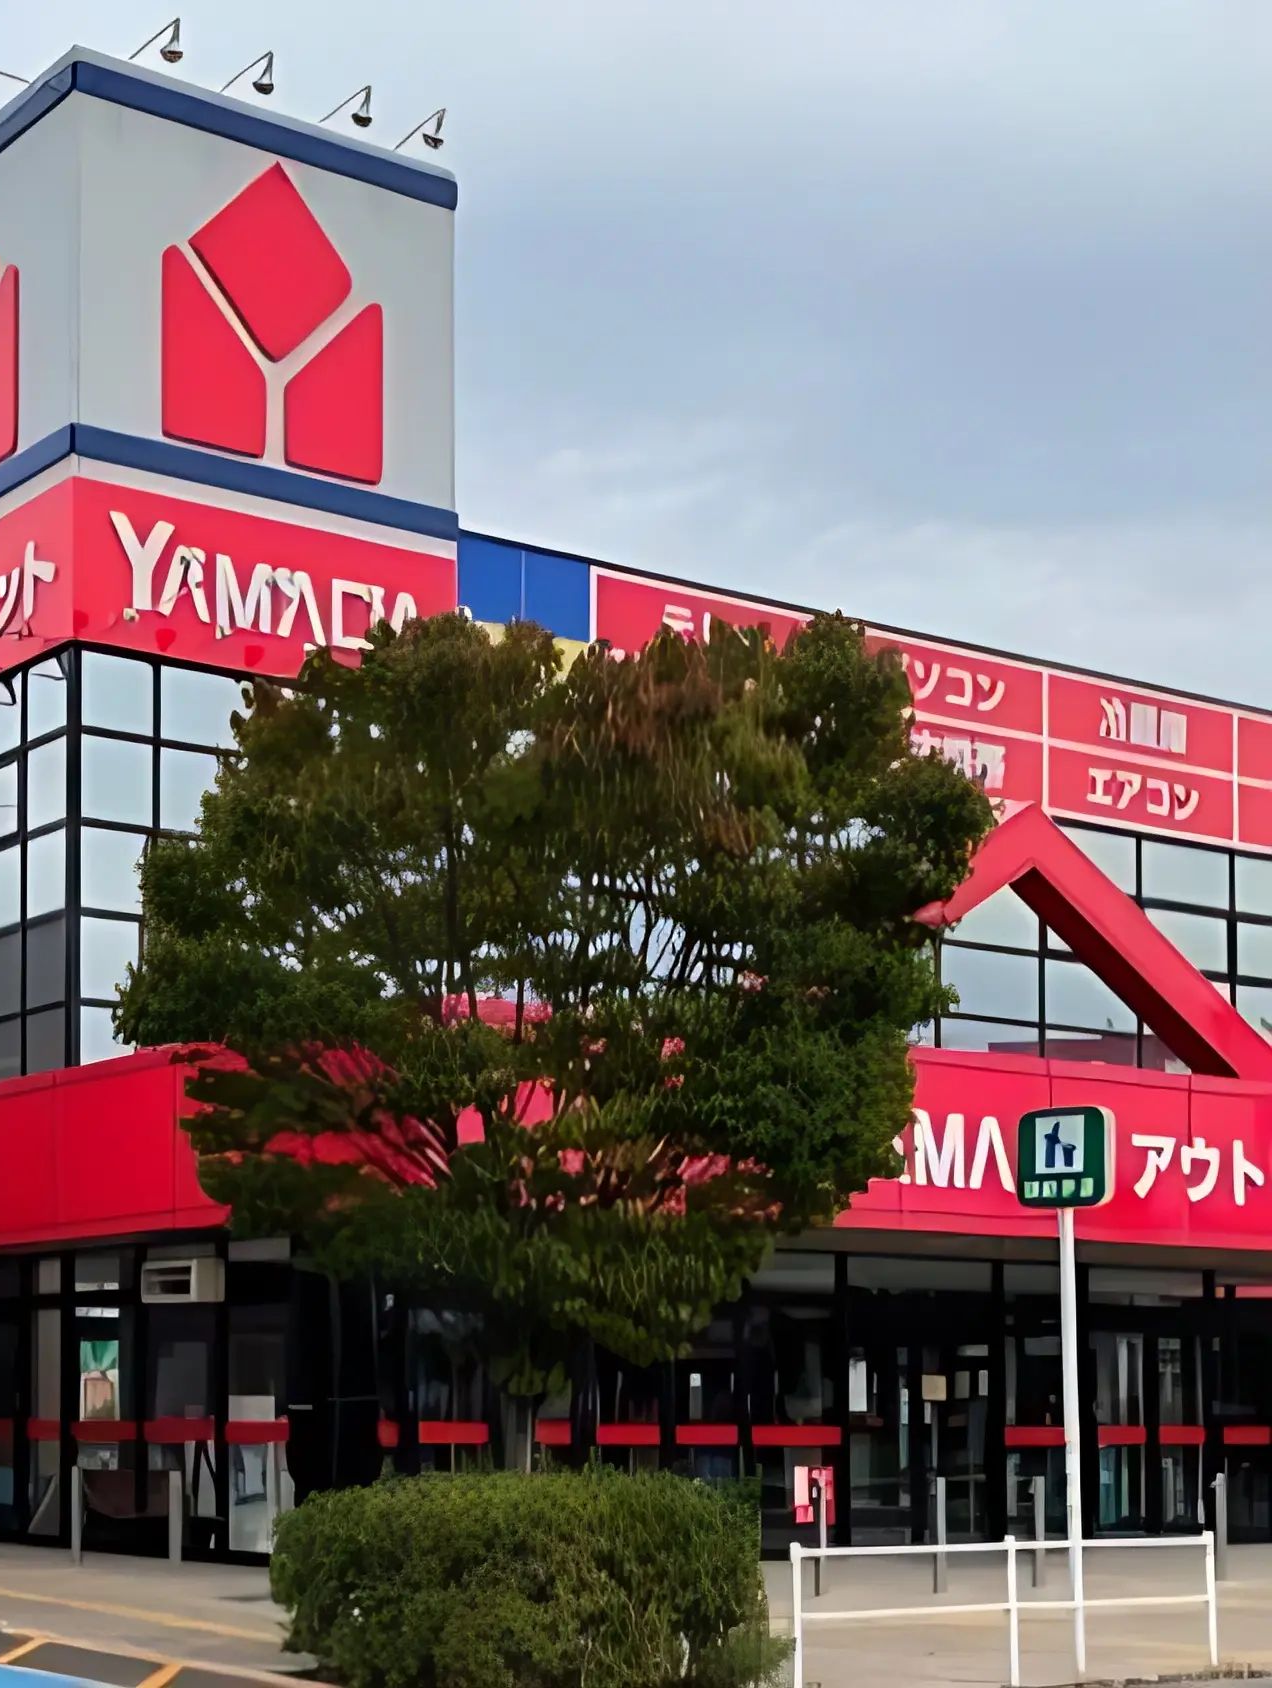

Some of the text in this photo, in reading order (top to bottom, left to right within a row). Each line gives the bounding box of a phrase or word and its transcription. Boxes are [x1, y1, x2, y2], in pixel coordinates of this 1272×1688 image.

[902, 652, 1006, 712] ソコン
[1086, 767, 1200, 821] エアコン
